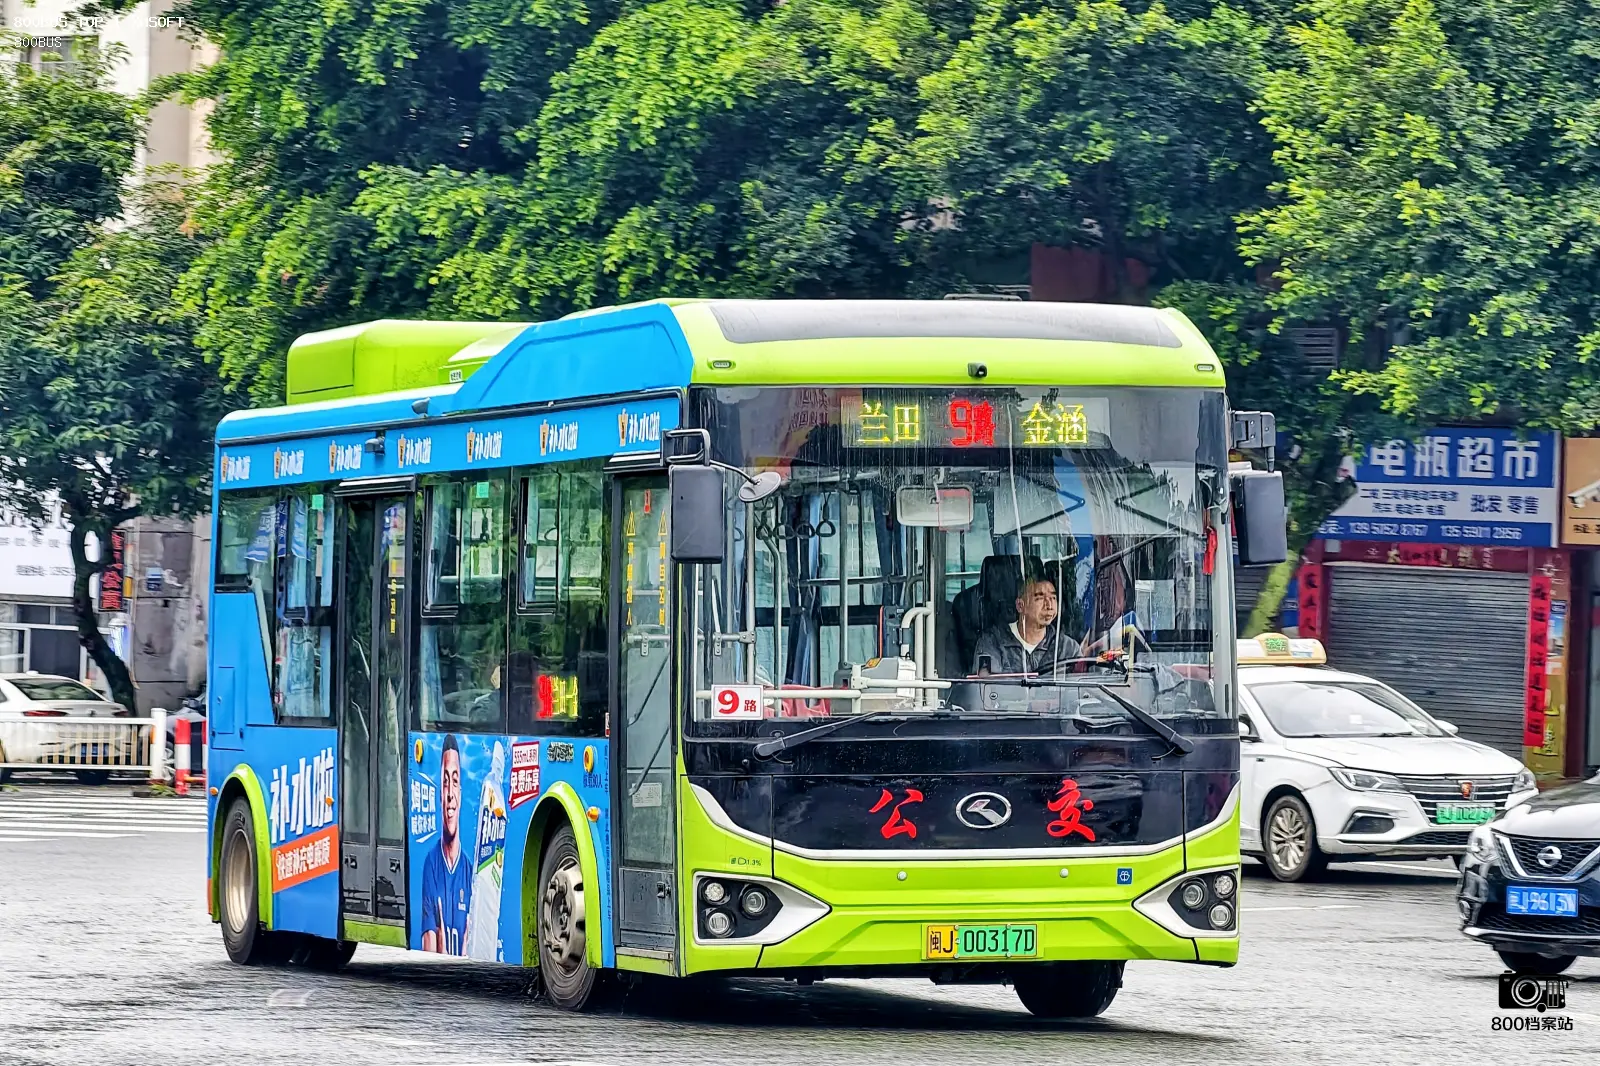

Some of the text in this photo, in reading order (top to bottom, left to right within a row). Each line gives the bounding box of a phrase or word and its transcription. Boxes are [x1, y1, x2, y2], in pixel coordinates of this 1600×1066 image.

[857, 402, 920, 443] 兰田
[1370, 436, 1540, 480] 电瓶超市
[1471, 494, 1539, 514] 批发 零售
[270, 747, 334, 844] 补水啦
[510, 768, 540, 794] 免费乐享
[868, 779, 1096, 842] 公 交
